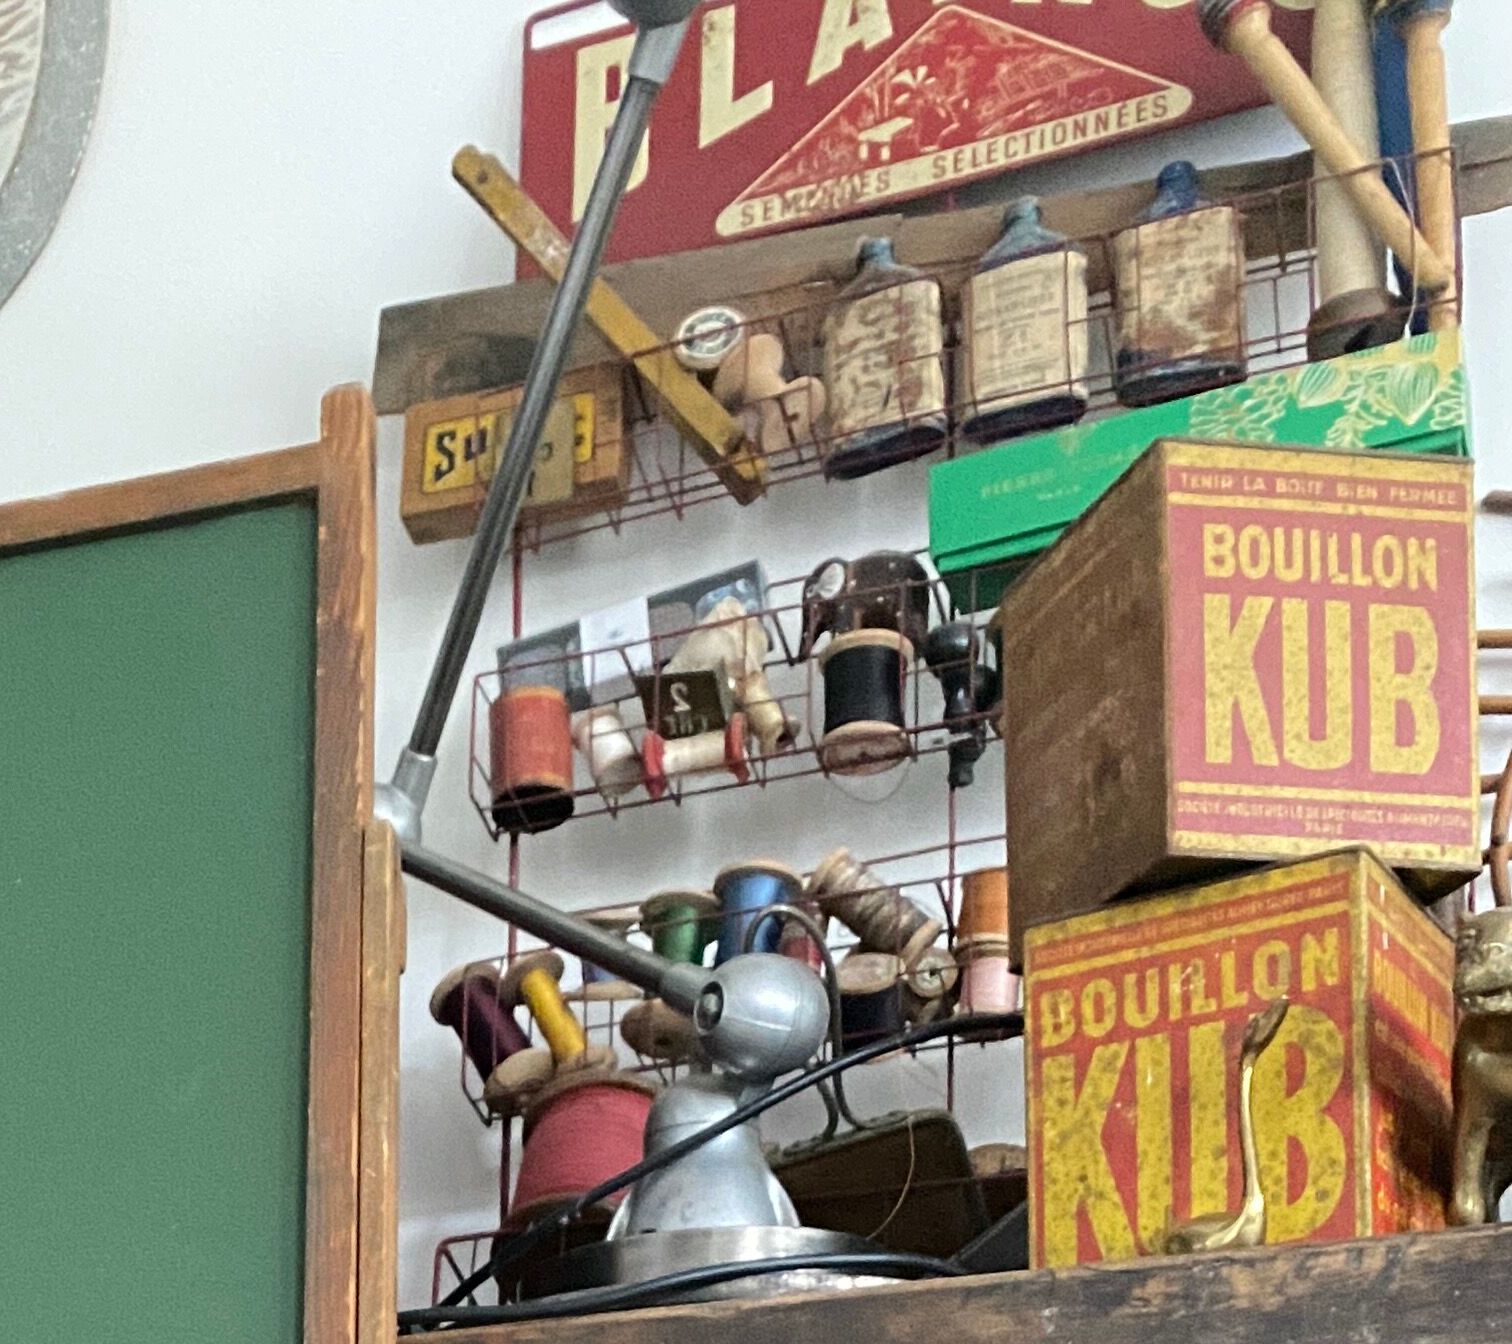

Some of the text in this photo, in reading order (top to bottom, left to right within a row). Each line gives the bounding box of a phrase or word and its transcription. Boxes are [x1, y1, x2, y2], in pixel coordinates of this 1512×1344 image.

[1181, 472, 1233, 490] TENIR
[1243, 475, 1266, 491] LA
[1336, 482, 1379, 501] BIEN
[1203, 523, 1437, 592] BOUILLON
[1204, 593, 1441, 775] KUB
[1040, 927, 1339, 1050] BOUILLON
[1041, 1004, 1347, 1269] KUB
